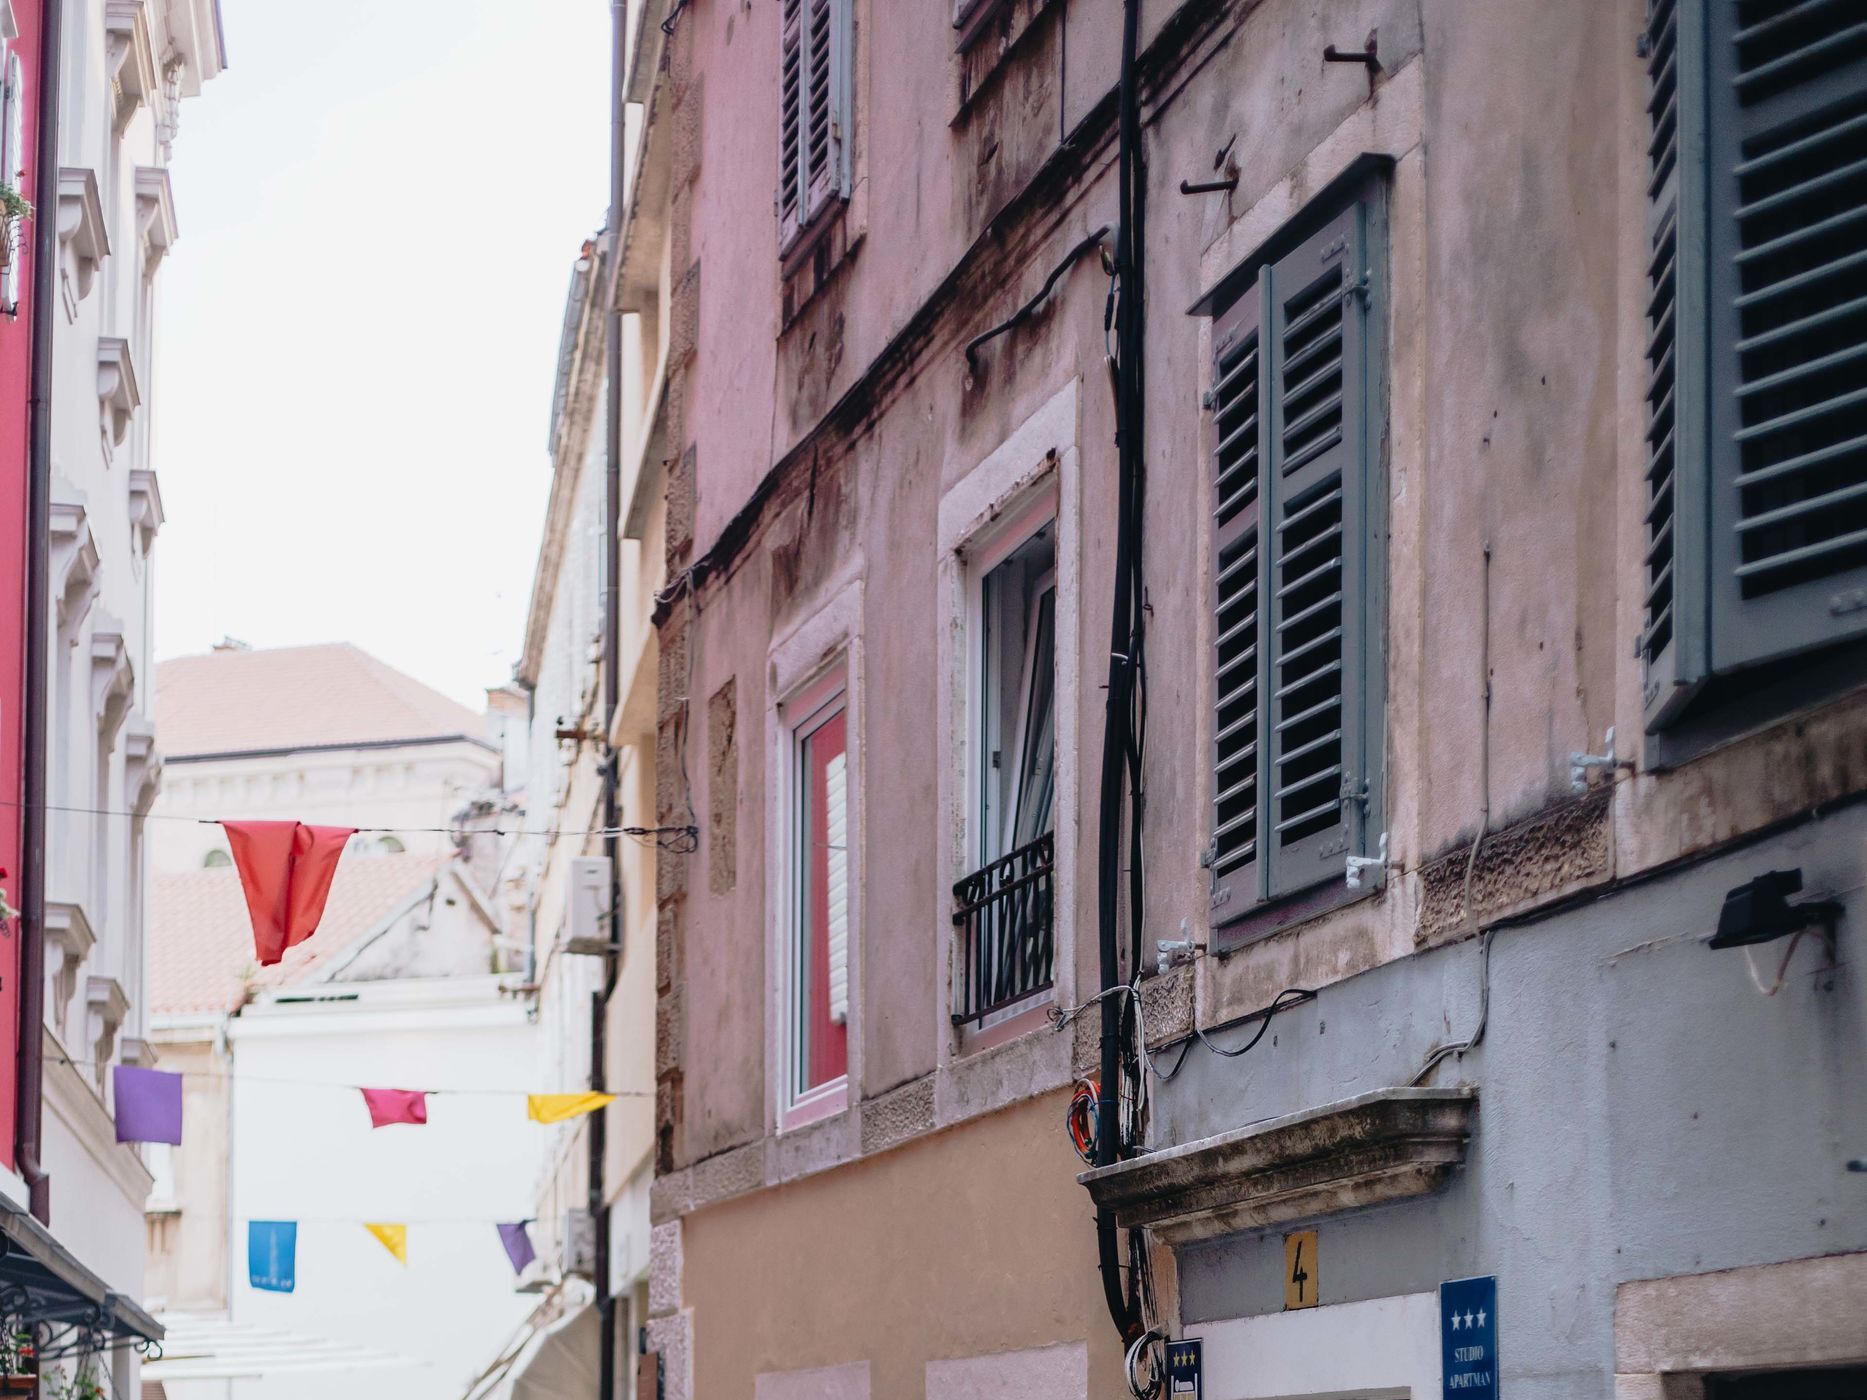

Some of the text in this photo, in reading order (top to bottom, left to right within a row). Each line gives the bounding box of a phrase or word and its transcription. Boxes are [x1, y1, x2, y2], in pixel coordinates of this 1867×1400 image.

[1292, 1240, 1308, 1303] 4
[1455, 1345, 1483, 1363] STUDIO
[1449, 1371, 1491, 1389] APARTMAN
